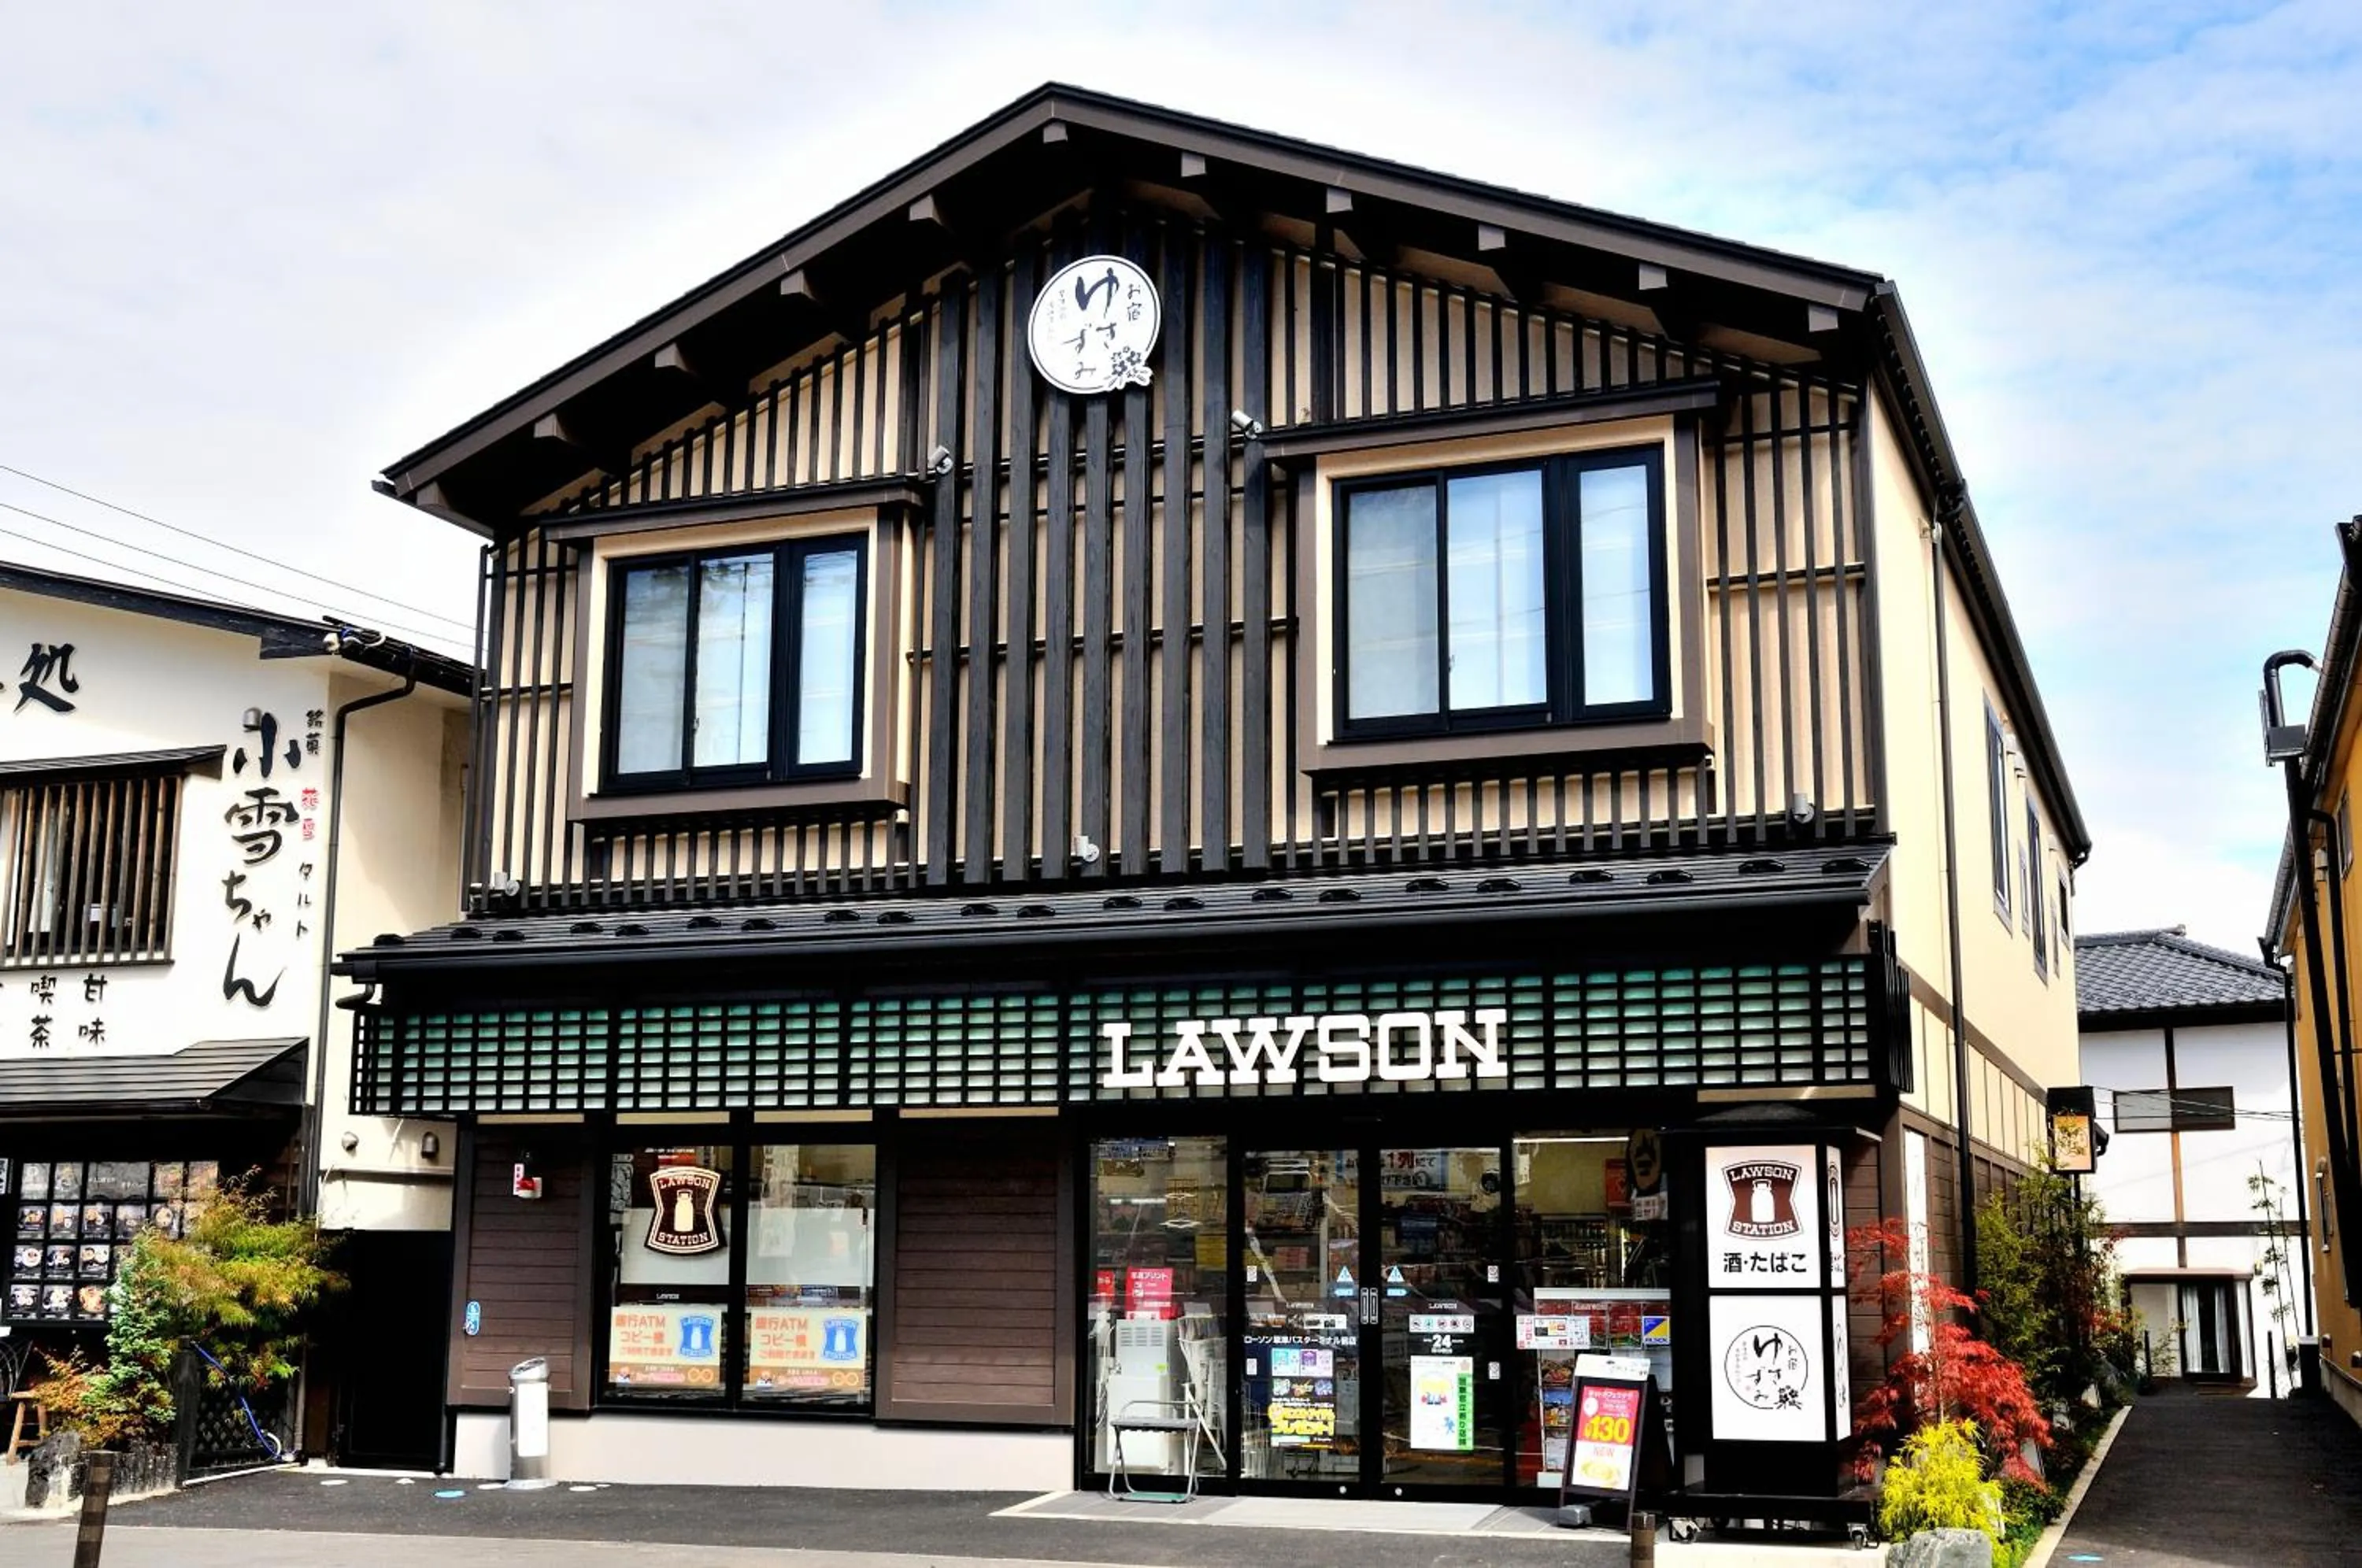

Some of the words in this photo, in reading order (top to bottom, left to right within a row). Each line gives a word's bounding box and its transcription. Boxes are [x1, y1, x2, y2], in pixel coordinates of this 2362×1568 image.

[223, 712, 301, 1008] 小雪ちゃん
[297, 861, 313, 937] タルト
[30, 974, 57, 1048] 喫茶
[79, 972, 108, 1045] 甘味
[1103, 1008, 1507, 1089] LAWSON
[659, 1175, 711, 1189] LAWSON
[1730, 1165, 1794, 1182] LAWSON
[1732, 1220, 1795, 1235] STATION
[657, 1232, 709, 1245] STATION
[1723, 1252, 1807, 1273] 酒・たばこ
[1432, 1334, 1453, 1348] 24
